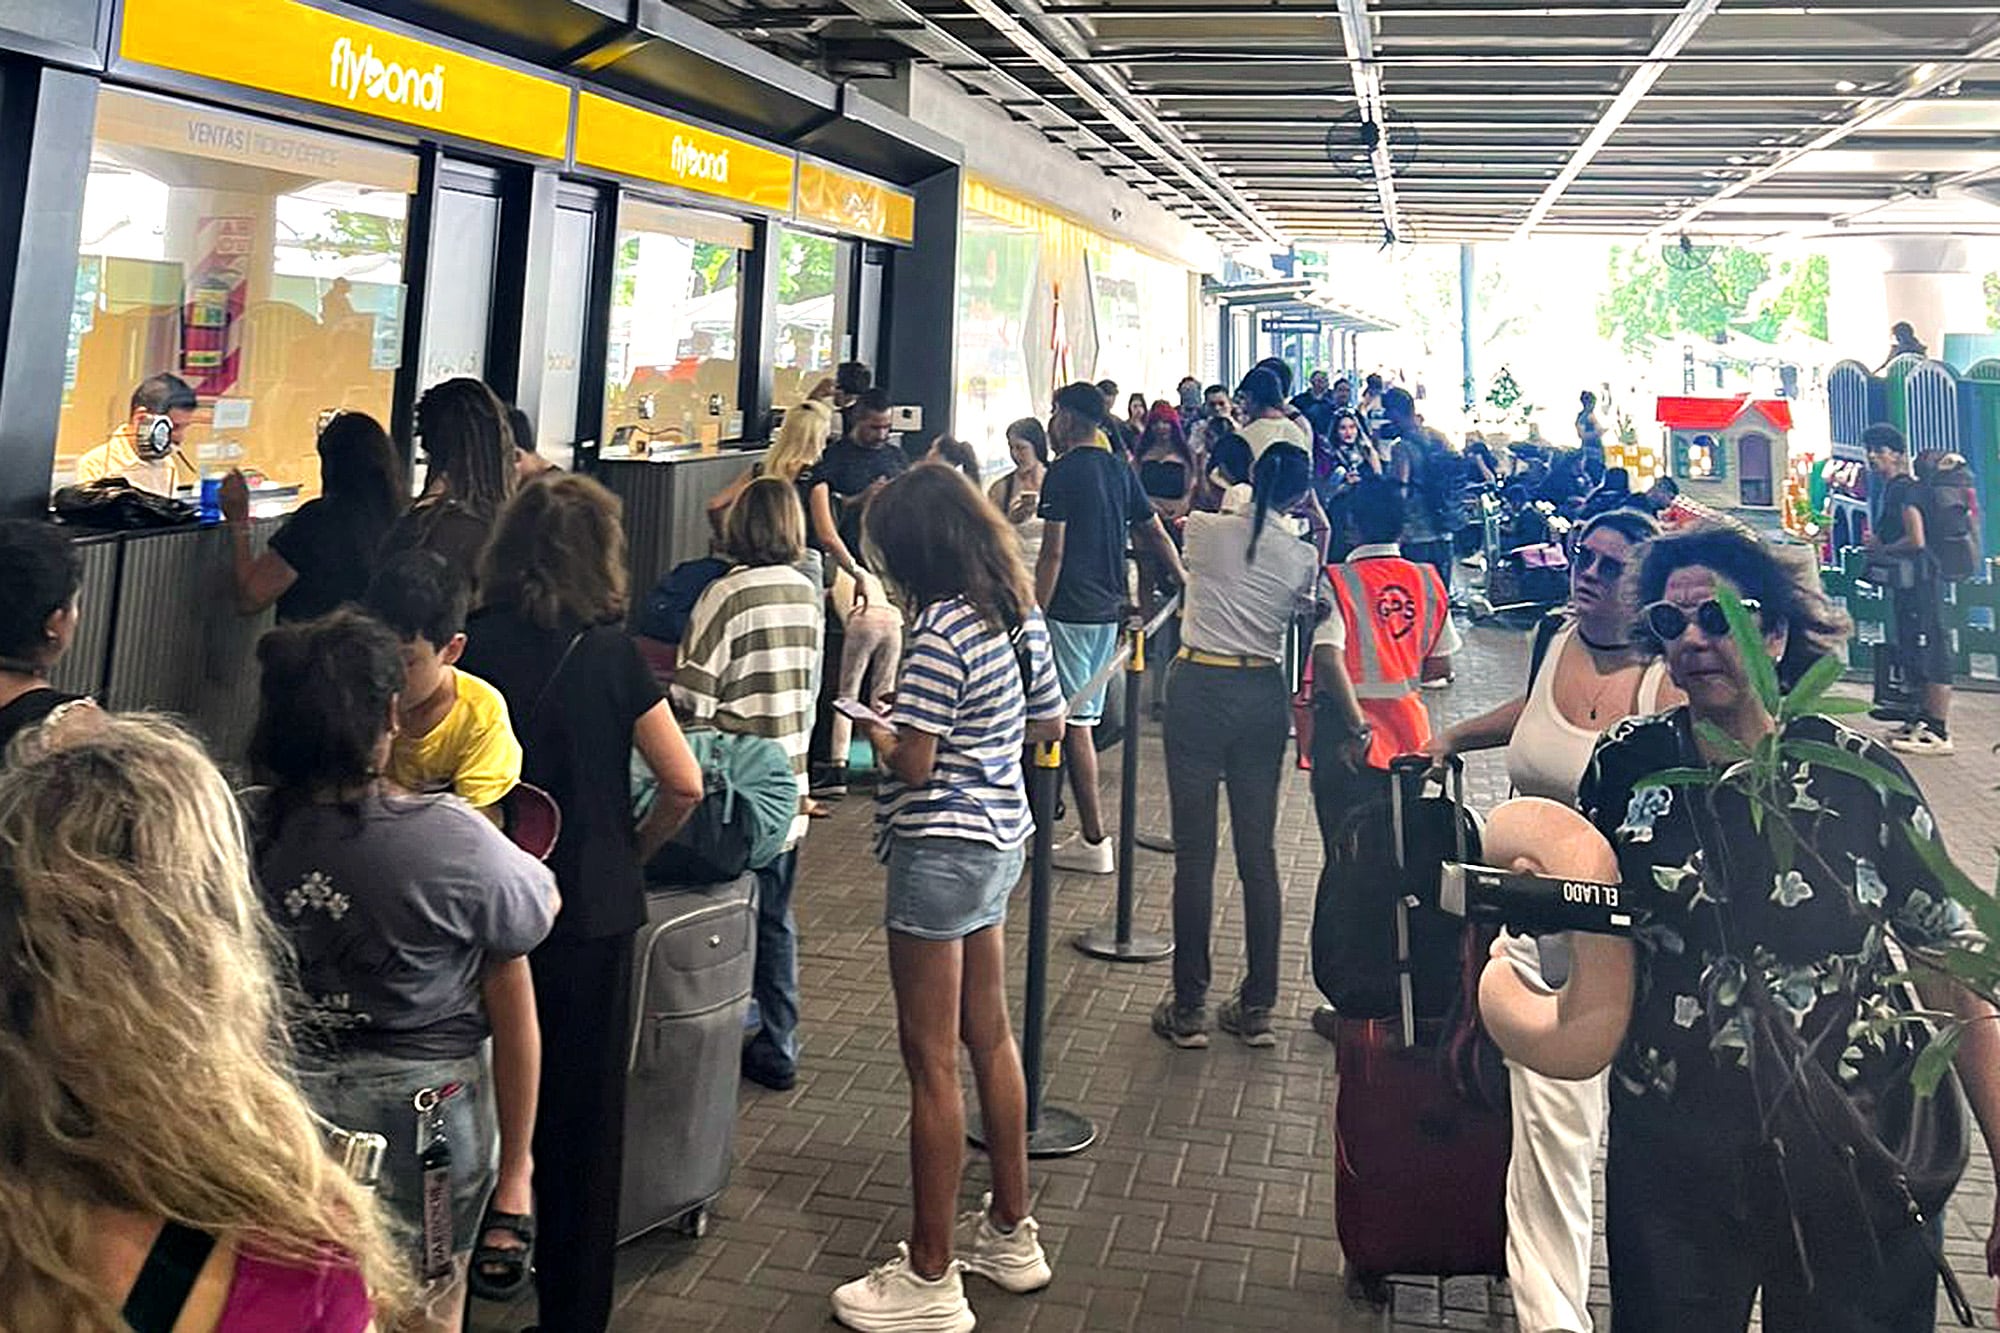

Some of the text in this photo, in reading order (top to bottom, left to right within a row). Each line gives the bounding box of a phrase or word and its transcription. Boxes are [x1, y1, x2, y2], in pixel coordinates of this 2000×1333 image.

[330, 36, 445, 113] flybondi
[188, 121, 244, 151] VENTAS
[671, 135, 729, 183] flybondi
[1376, 598, 1415, 620] GPS
[1563, 882, 1619, 907] EL LADO
